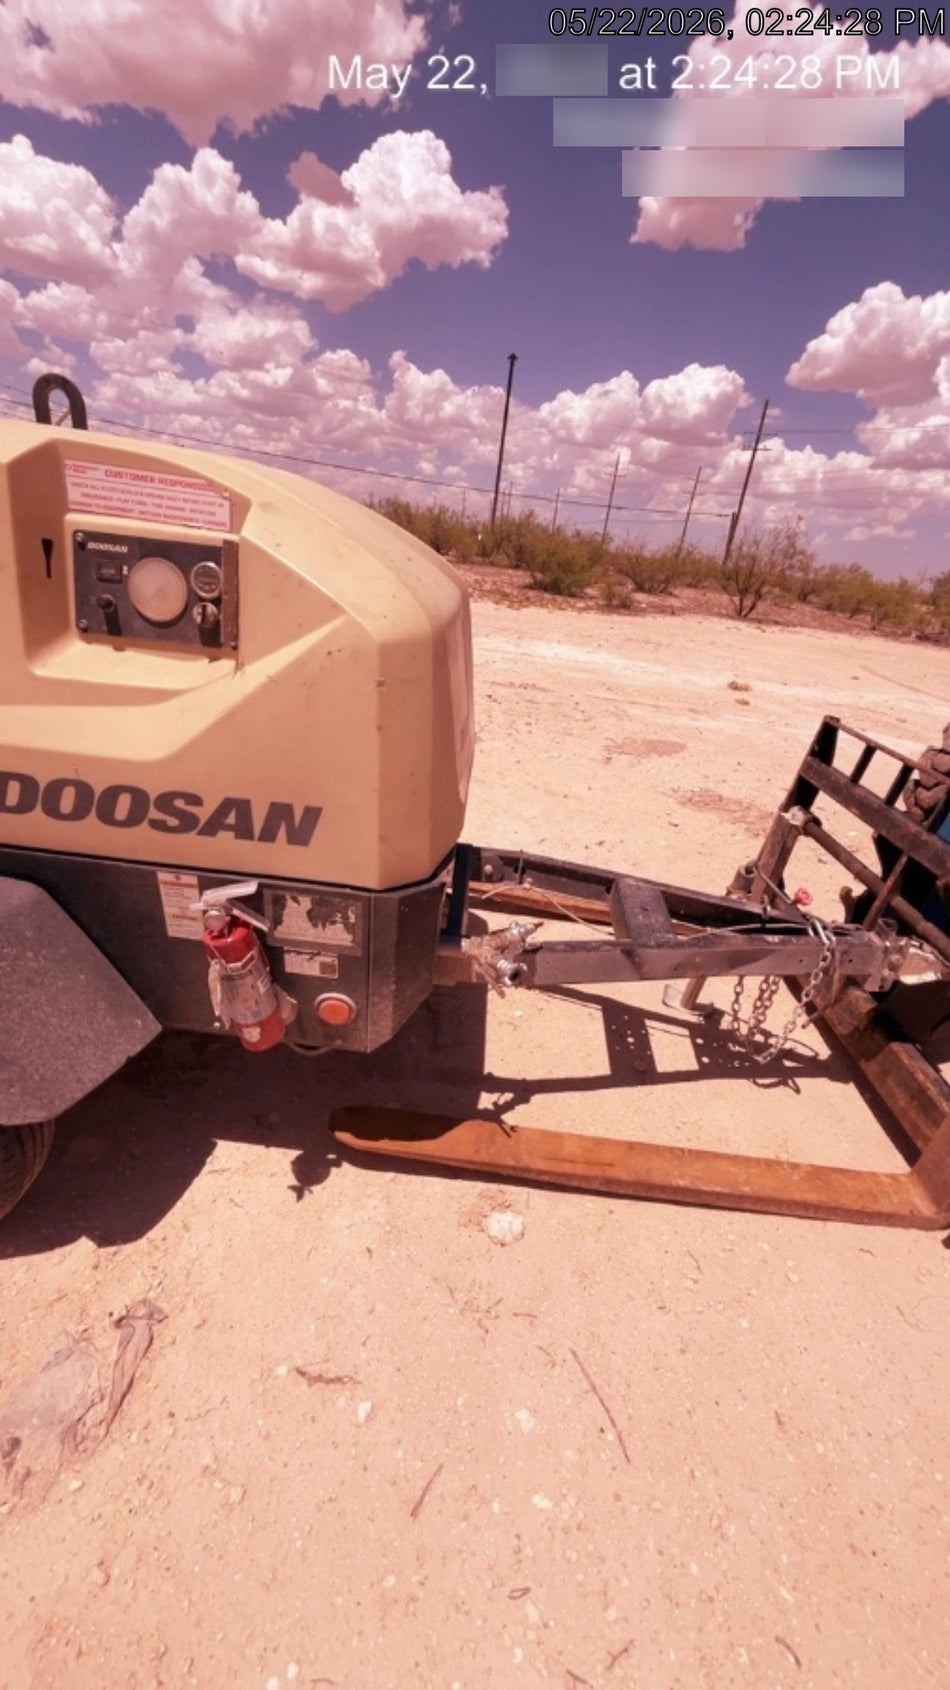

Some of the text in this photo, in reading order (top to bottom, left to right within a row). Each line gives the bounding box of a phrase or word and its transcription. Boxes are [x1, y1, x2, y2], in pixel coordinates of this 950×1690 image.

[104, 469, 156, 483] CUSTOMER
[87, 541, 128, 553] DOOSAN
[0, 771, 323, 847] DOOSAN
